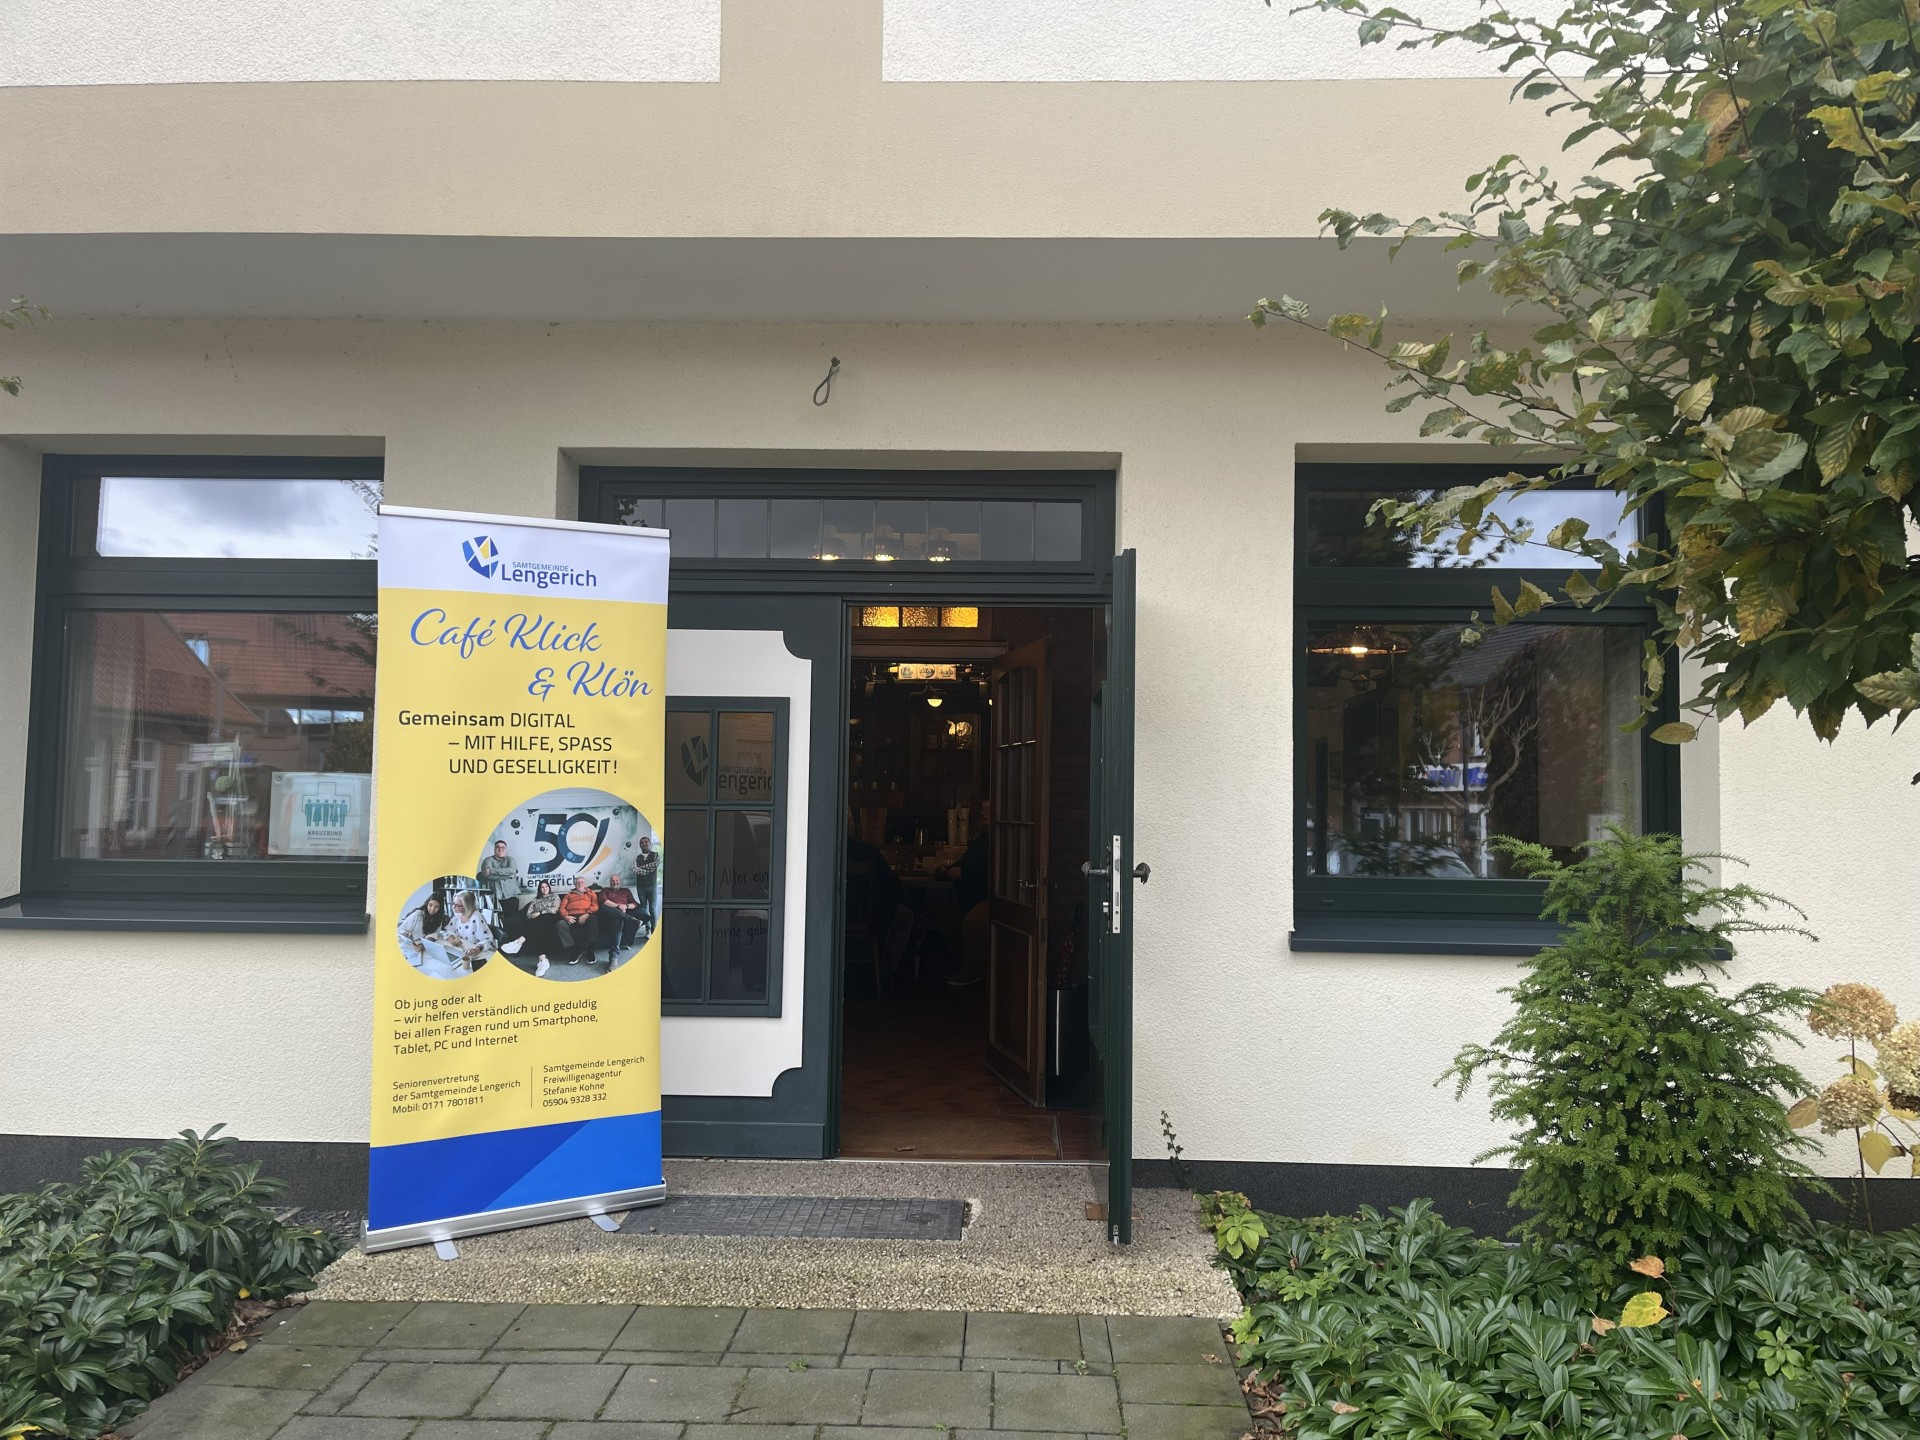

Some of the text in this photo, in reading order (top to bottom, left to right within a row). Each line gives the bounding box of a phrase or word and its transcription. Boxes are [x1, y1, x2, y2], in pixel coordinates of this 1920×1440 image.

[512, 561, 569, 572] SAMTGEMEINDE
[501, 563, 597, 589] Lengerich
[409, 608, 603, 660] Café Klick
[527, 660, 653, 702] & Klön
[398, 710, 575, 728] Gemeinsam DIGITAL
[465, 735, 496, 750] MIT
[500, 735, 554, 753] HILFE,
[558, 736, 612, 752] SPASS
[449, 758, 618, 775] UND GESELLIGKEIT!
[394, 993, 482, 1011] Ob jung oder alt
[404, 1013, 422, 1024] wir
[425, 1010, 459, 1022] helfen
[462, 1004, 528, 1019] verständlich
[530, 1002, 550, 1013] und
[553, 999, 597, 1013] geduldig
[394, 1014, 598, 1040] bei allen Fragen rund um Smartphone,
[393, 1034, 518, 1055] Tablet, PC und Internet
[543, 1055, 645, 1073] Samtgemeinde Lengerich
[392, 1074, 480, 1090] Seniorenvertretung
[543, 1069, 622, 1085] Freiwilligenagentur
[392, 1079, 521, 1102] der Samtgemeinde Lengerich
[543, 1084, 577, 1096] Stefanie
[392, 1096, 484, 1114] Mobil: 0171 7801811
[542, 1092, 607, 1107] 05904 9328 332
